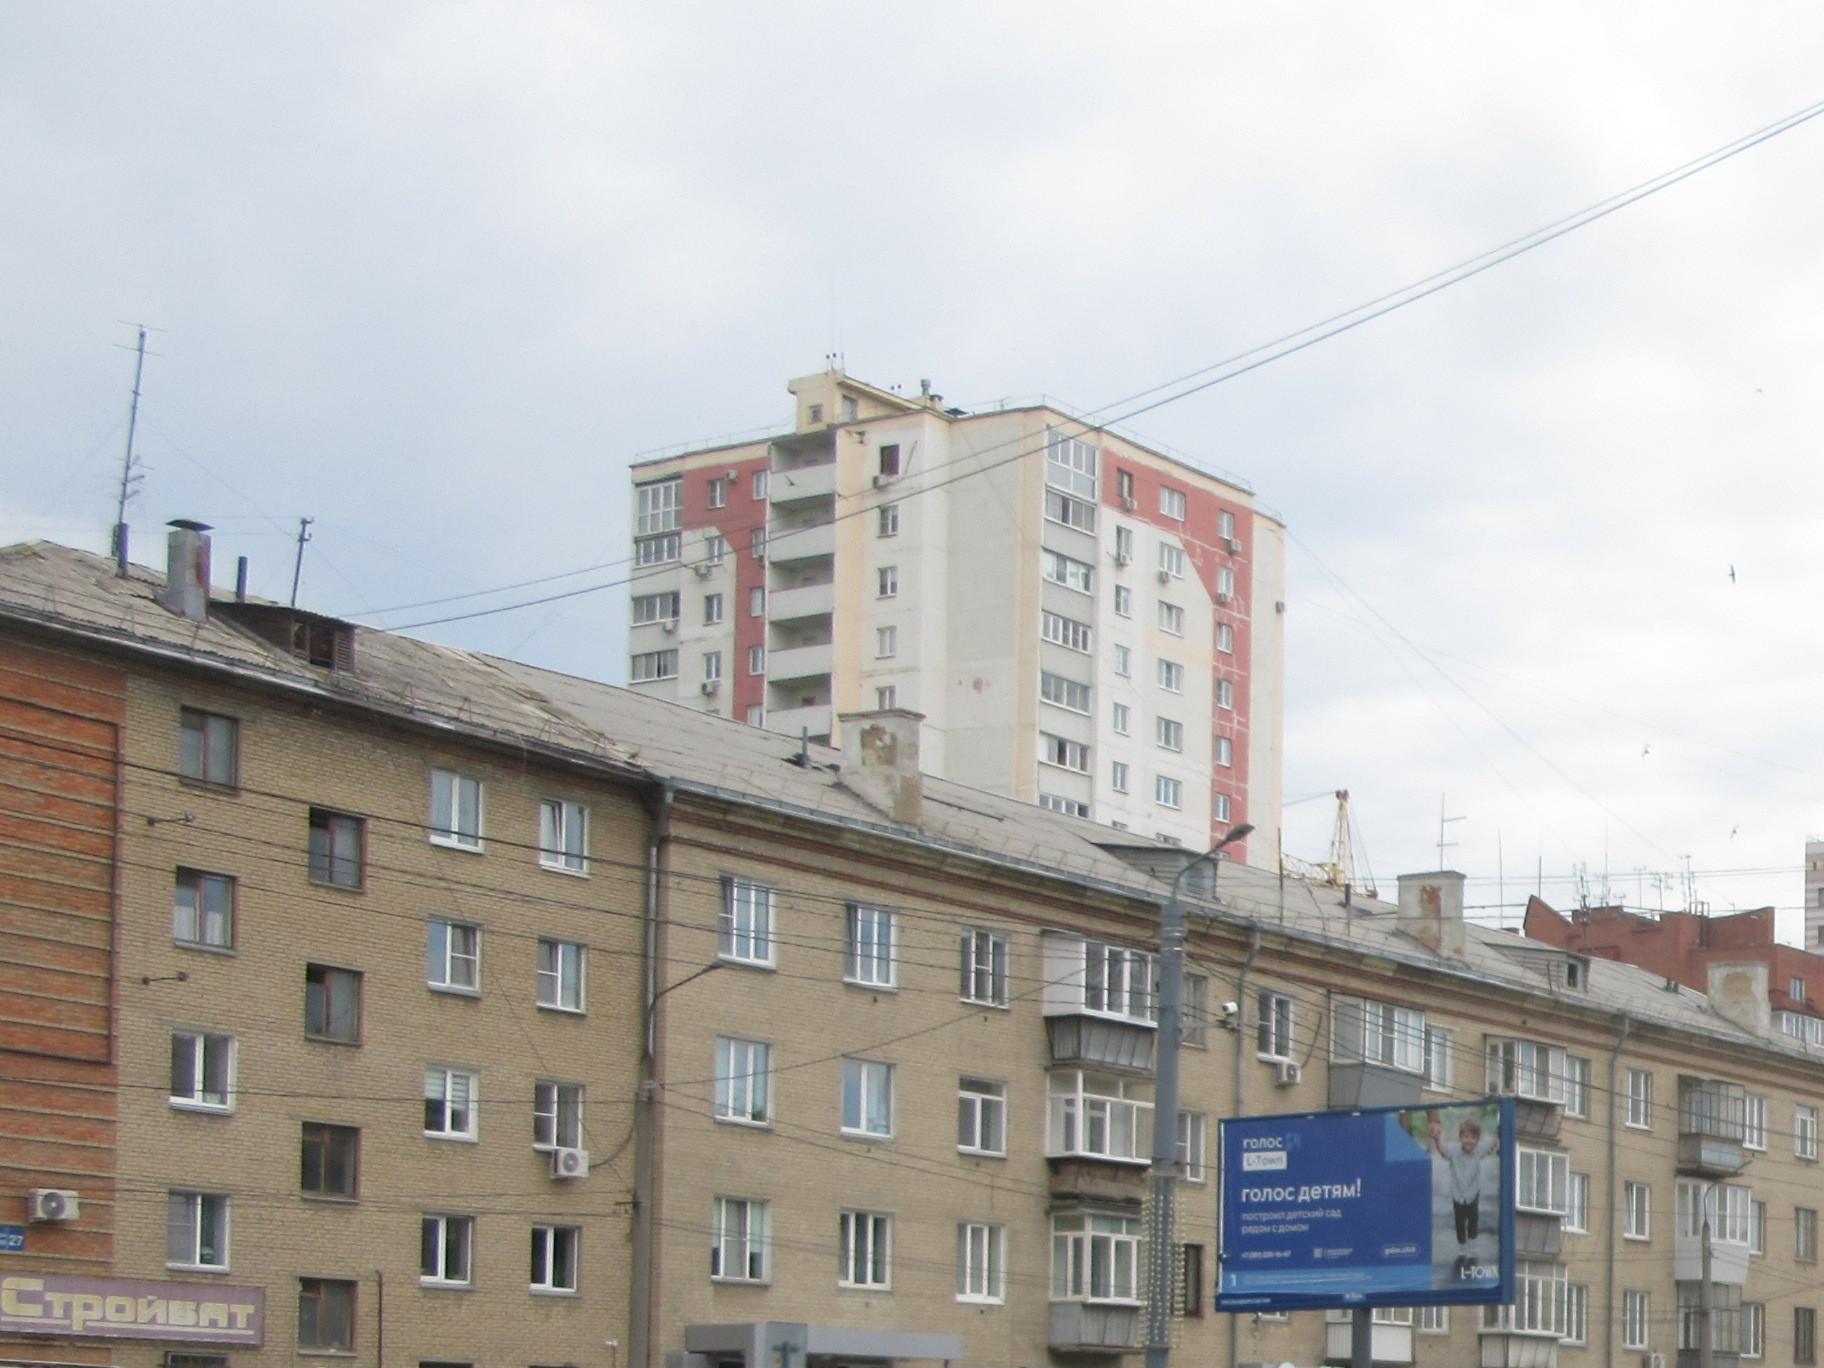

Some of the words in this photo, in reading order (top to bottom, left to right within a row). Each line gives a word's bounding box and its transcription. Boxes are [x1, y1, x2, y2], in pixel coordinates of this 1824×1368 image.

[1243, 1137, 1283, 1149] голос
[1242, 1187, 1296, 1202] голос
[1298, 1178, 1361, 1202] детям!
[1325, 1209, 1342, 1218] сад
[1, 1277, 256, 1331] Стройбат
